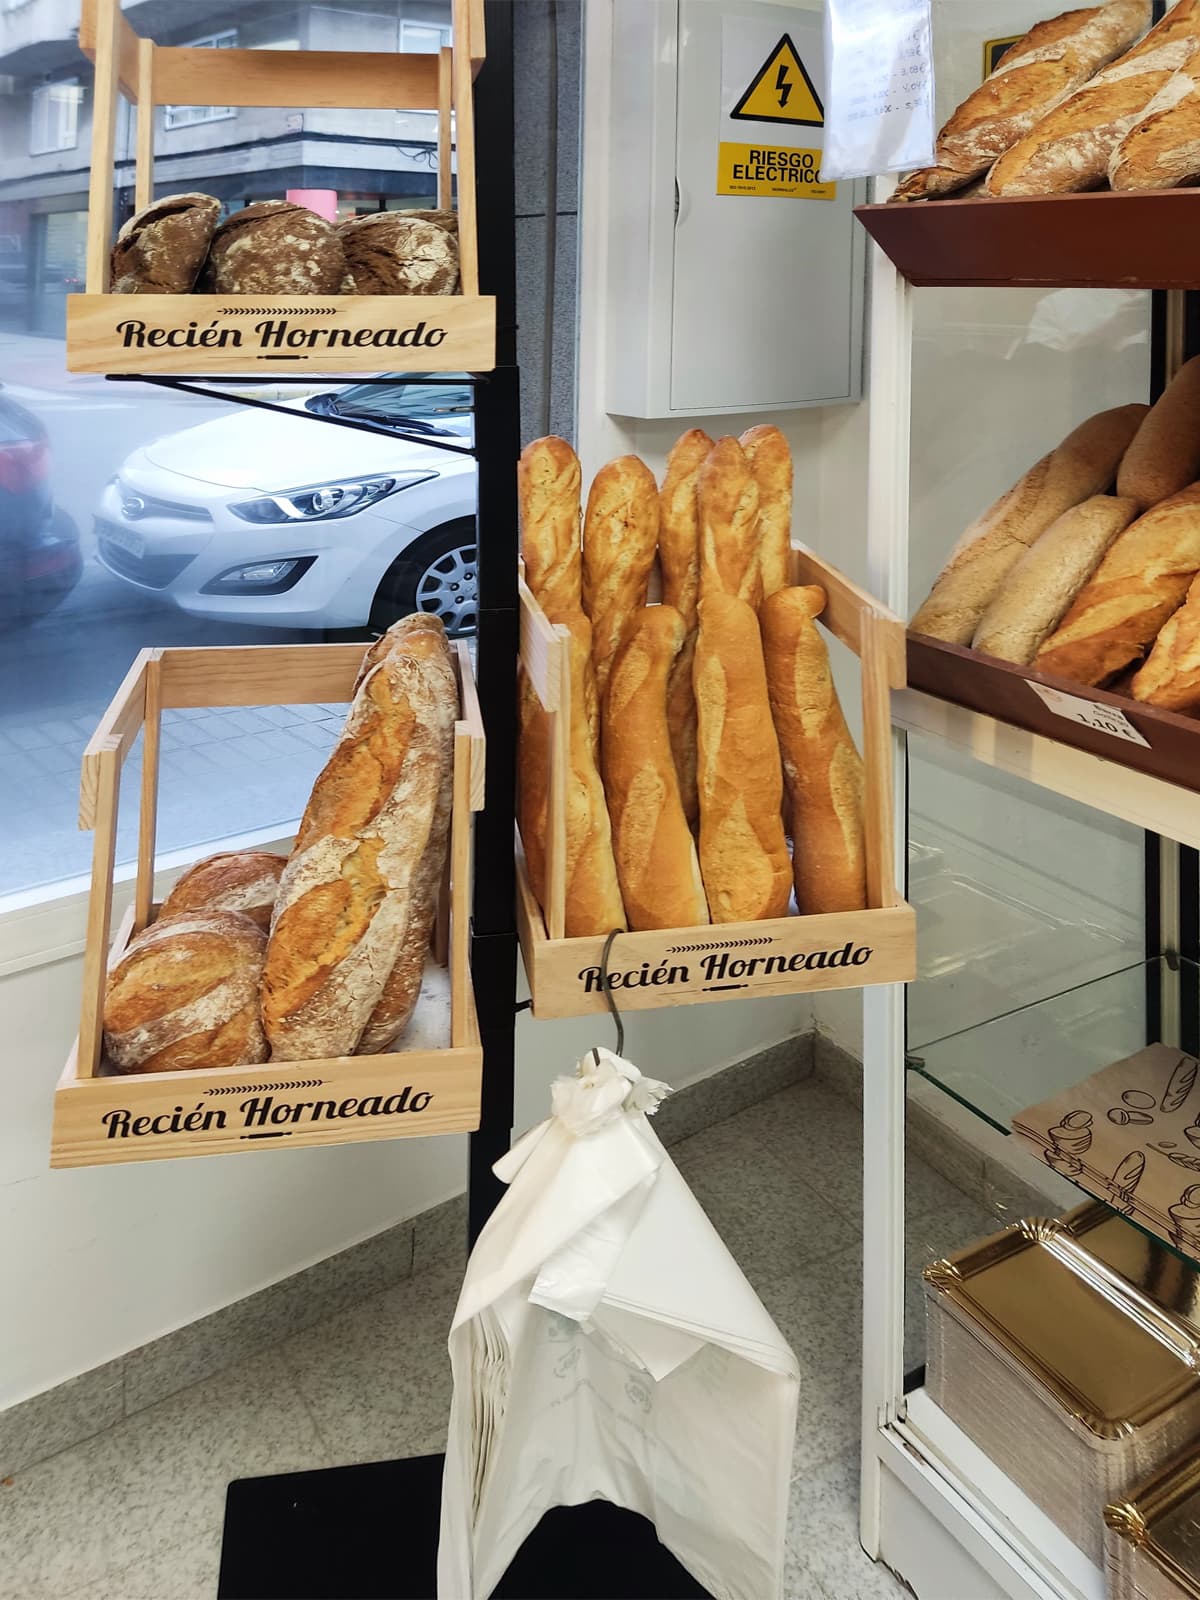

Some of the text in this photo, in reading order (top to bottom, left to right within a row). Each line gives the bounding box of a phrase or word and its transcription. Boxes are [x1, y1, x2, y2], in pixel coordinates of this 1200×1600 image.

[749, 149, 814, 168] RIESGO
[116, 320, 448, 348] Recién Horneado
[1076, 713, 1118, 733] 1,10
[578, 942, 873, 993] Recién Horneado
[102, 1086, 434, 1139] Recién Horneado
